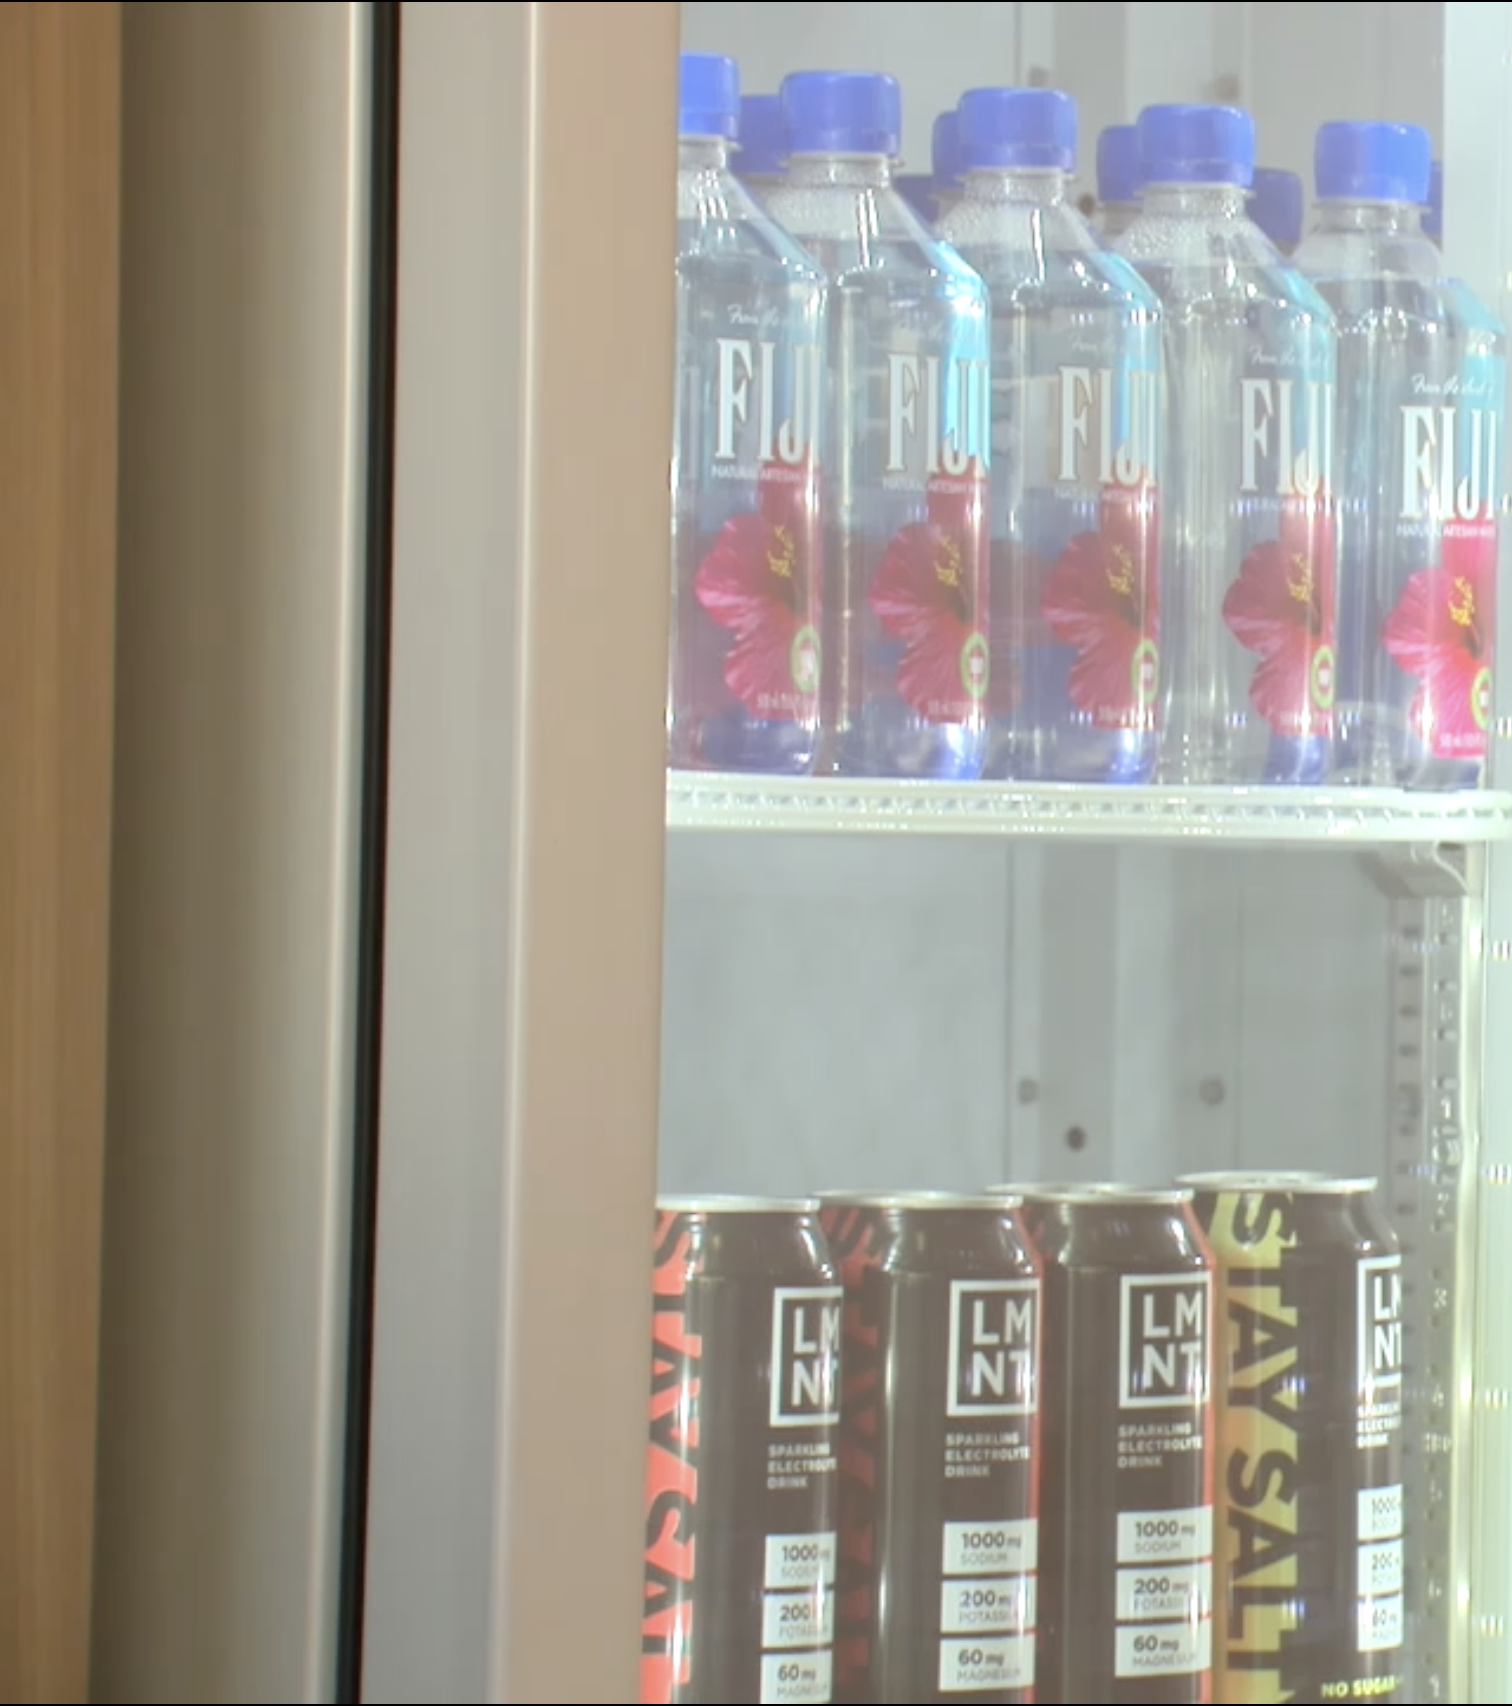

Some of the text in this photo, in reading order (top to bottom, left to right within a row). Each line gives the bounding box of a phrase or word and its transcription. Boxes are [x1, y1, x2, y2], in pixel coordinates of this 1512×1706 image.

[715, 338, 821, 466] FIJI
[886, 353, 990, 477] FIJI
[1058, 366, 1157, 487] FIJI
[1240, 378, 1334, 496] FIJI
[1399, 405, 1497, 521] FIJI
[972, 1298, 1032, 1346] LM
[1143, 1290, 1203, 1339] LM
[971, 1350, 1032, 1397] NT
[1141, 1341, 1203, 1391] NT
[1117, 1421, 1192, 1438] SPARKLING
[945, 1432, 1019, 1447] SPARKLING
[1226, 1192, 1299, 1703] STAY SALT
[944, 1464, 990, 1479] DRINK
[1117, 1455, 1163, 1469] DRINK
[767, 1475, 808, 1490] DRINK
[1134, 1520, 1196, 1538] 1000 mg
[962, 1531, 1005, 1550] 1000
[1134, 1577, 1170, 1595] 200
[960, 1590, 996, 1607] 200
[779, 1604, 809, 1622] 200
[1133, 1634, 1180, 1654] 60 mg
[958, 1648, 1005, 1668] 60 mg
[777, 1664, 799, 1682] 60
[1321, 1682, 1348, 1698] NO
